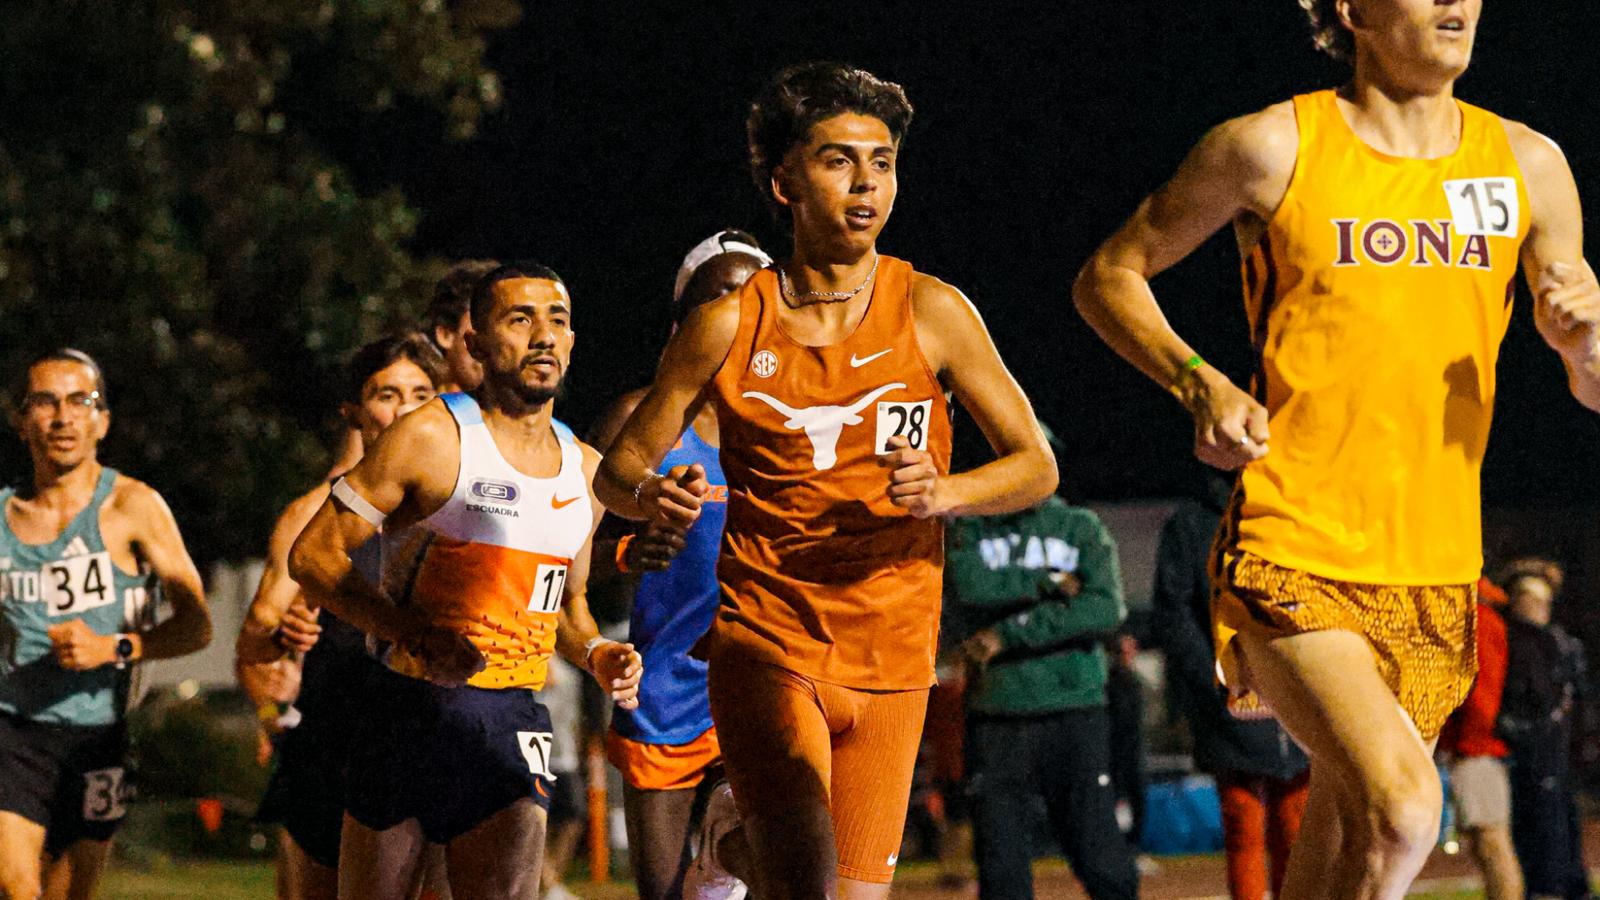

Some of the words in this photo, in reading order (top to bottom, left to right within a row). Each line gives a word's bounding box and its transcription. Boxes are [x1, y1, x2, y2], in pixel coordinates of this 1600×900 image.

[1460, 182, 1509, 232] 15
[1330, 218, 1492, 271] IONA
[753, 351, 777, 377] SEC
[884, 404, 925, 452] 28
[51, 558, 107, 611] 34
[542, 569, 566, 611] 17
